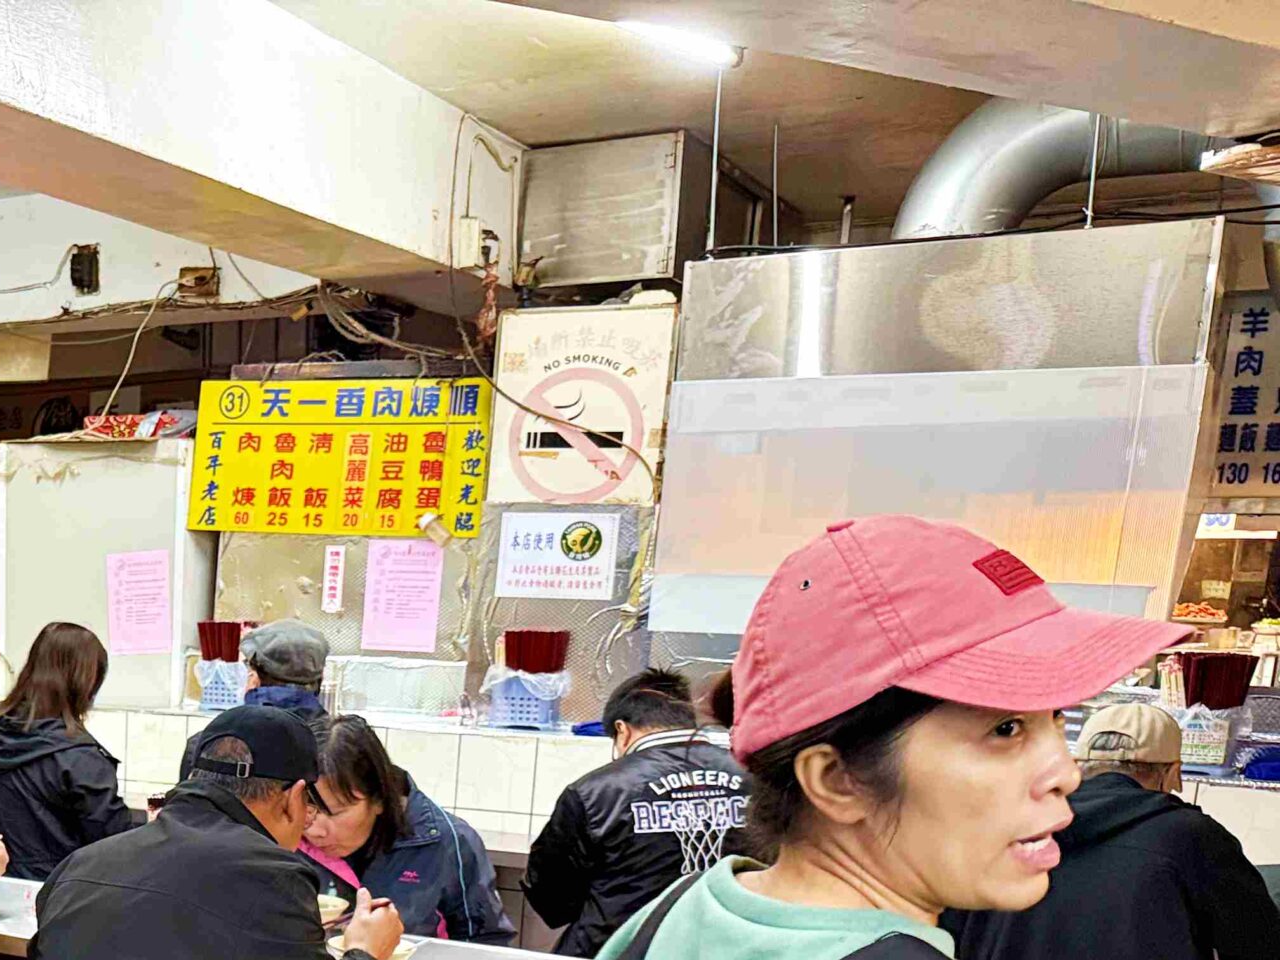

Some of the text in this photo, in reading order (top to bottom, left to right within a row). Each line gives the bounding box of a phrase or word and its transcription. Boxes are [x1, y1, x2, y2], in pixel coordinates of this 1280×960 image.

[544, 354, 621, 373] NO SMOKING
[198, 430, 226, 526] 百年老店
[267, 432, 296, 508] 魯肉飯
[342, 433, 370, 509] 高麗菜
[376, 432, 408, 510] 油豆腐
[1217, 462, 1249, 485] 130
[234, 512, 395, 528] 60 25 15 20 15
[648, 770, 743, 795] LIONEERS
[631, 796, 751, 833] RESPEC
